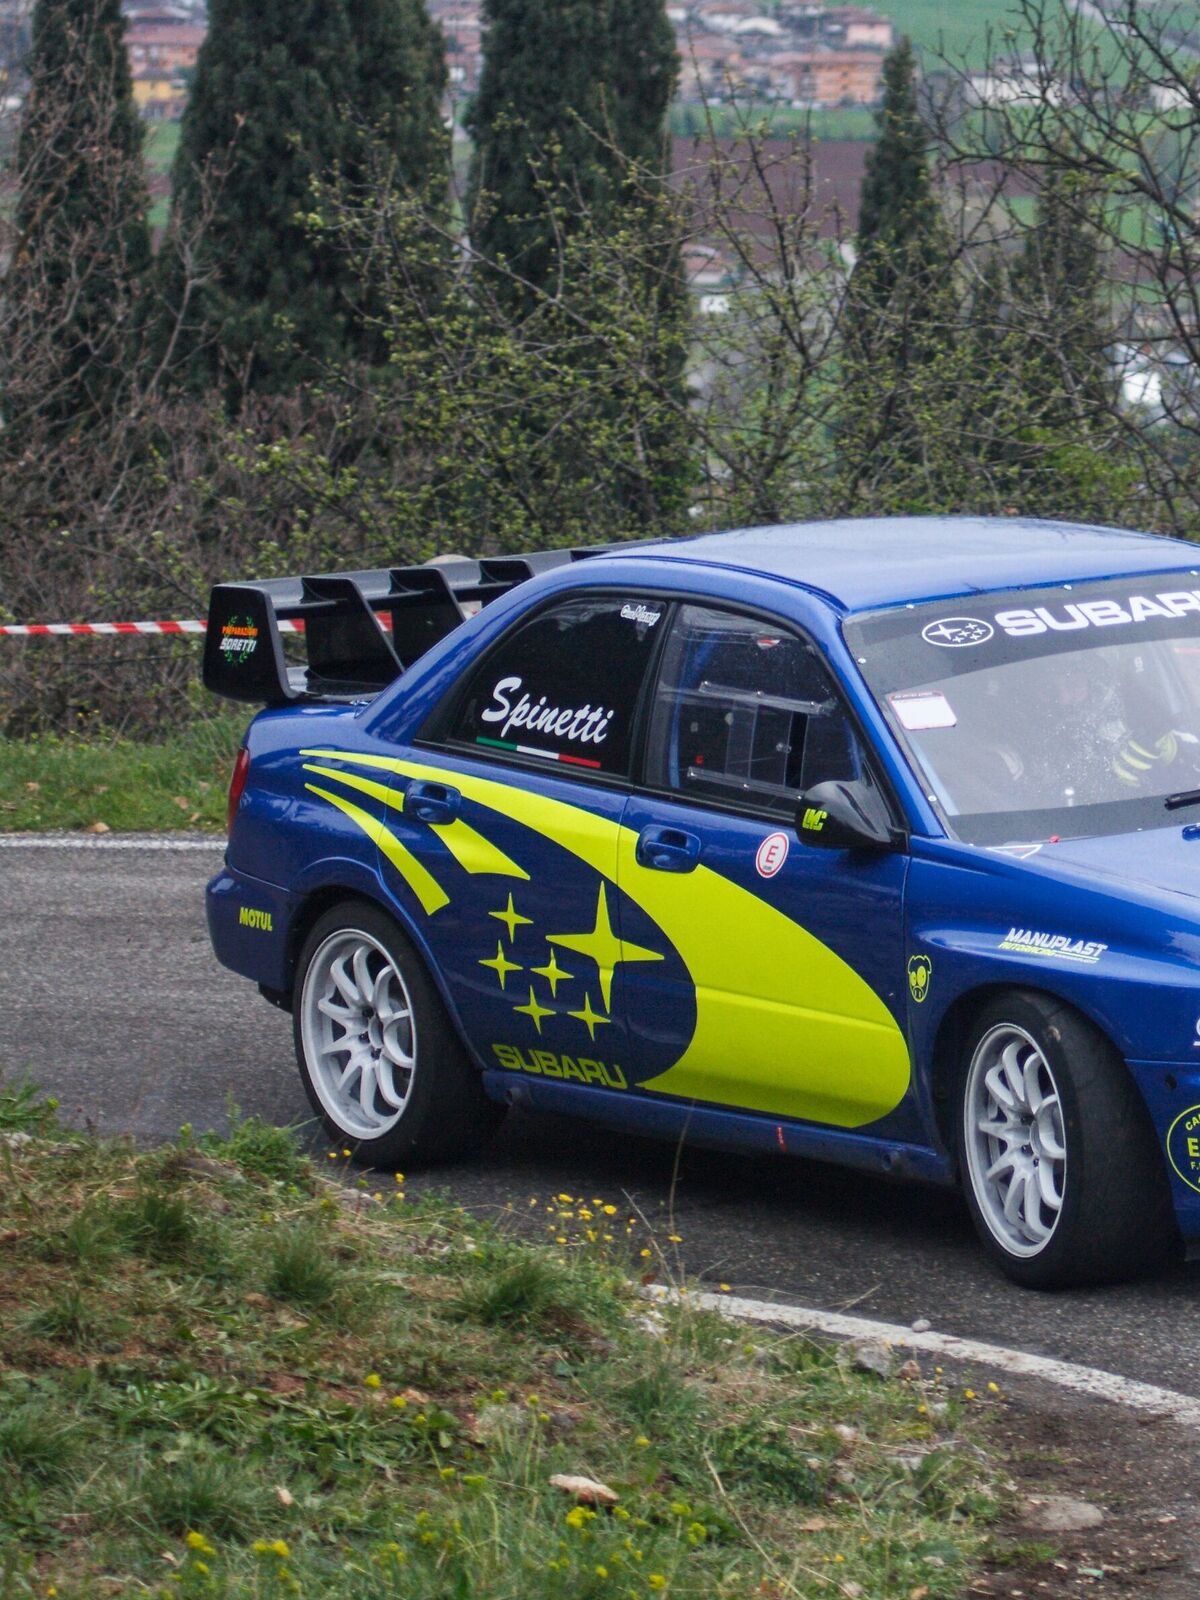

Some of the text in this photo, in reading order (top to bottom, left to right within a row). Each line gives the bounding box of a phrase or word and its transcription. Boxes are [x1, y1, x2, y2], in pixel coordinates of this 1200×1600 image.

[481, 676, 615, 743] Spinetti
[765, 845, 779, 863] E
[239, 906, 273, 932] MOTUL
[1004, 927, 1108, 957] MANUPLAST
[491, 1043, 629, 1090] SUBARU
